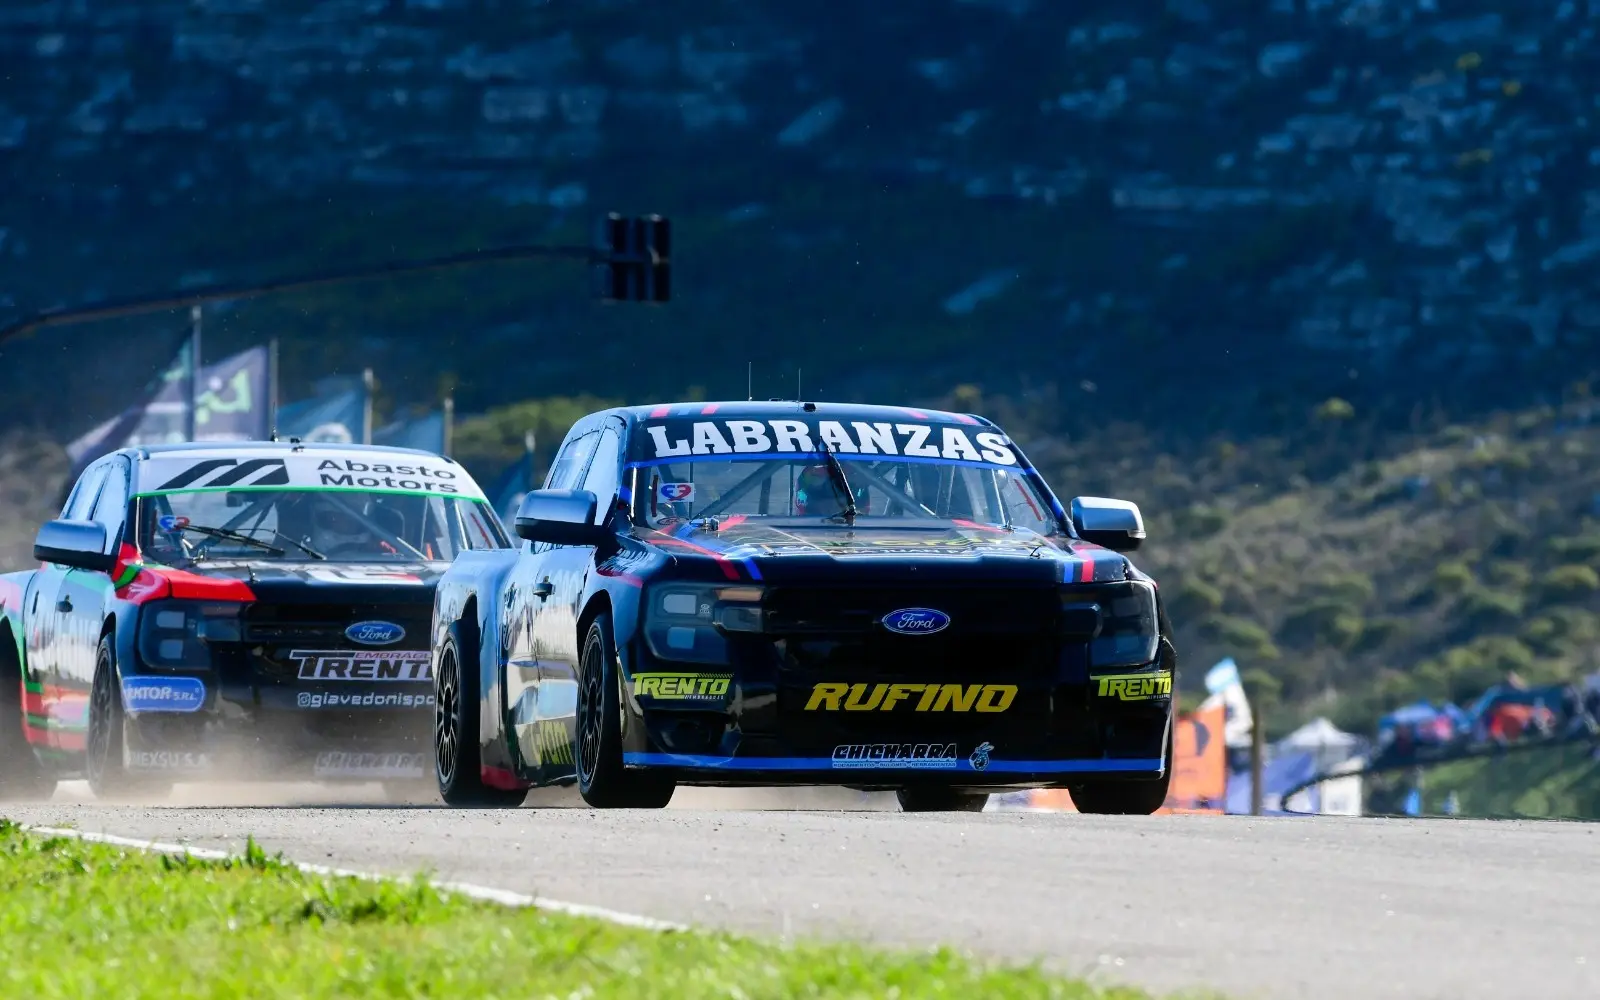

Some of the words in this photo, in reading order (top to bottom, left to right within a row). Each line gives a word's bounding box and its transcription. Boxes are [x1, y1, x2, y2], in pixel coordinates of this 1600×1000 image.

[647, 420, 1018, 466] LABRANZAS
[317, 459, 456, 480] Abasto
[319, 473, 458, 494] Motors
[897, 612, 935, 629] Ford
[358, 625, 393, 640] Ford
[631, 673, 731, 700] TRENTO
[804, 682, 1019, 712] RUFINO
[1090, 672, 1172, 701] TRENTO
[832, 743, 958, 761] CHICHARRA
